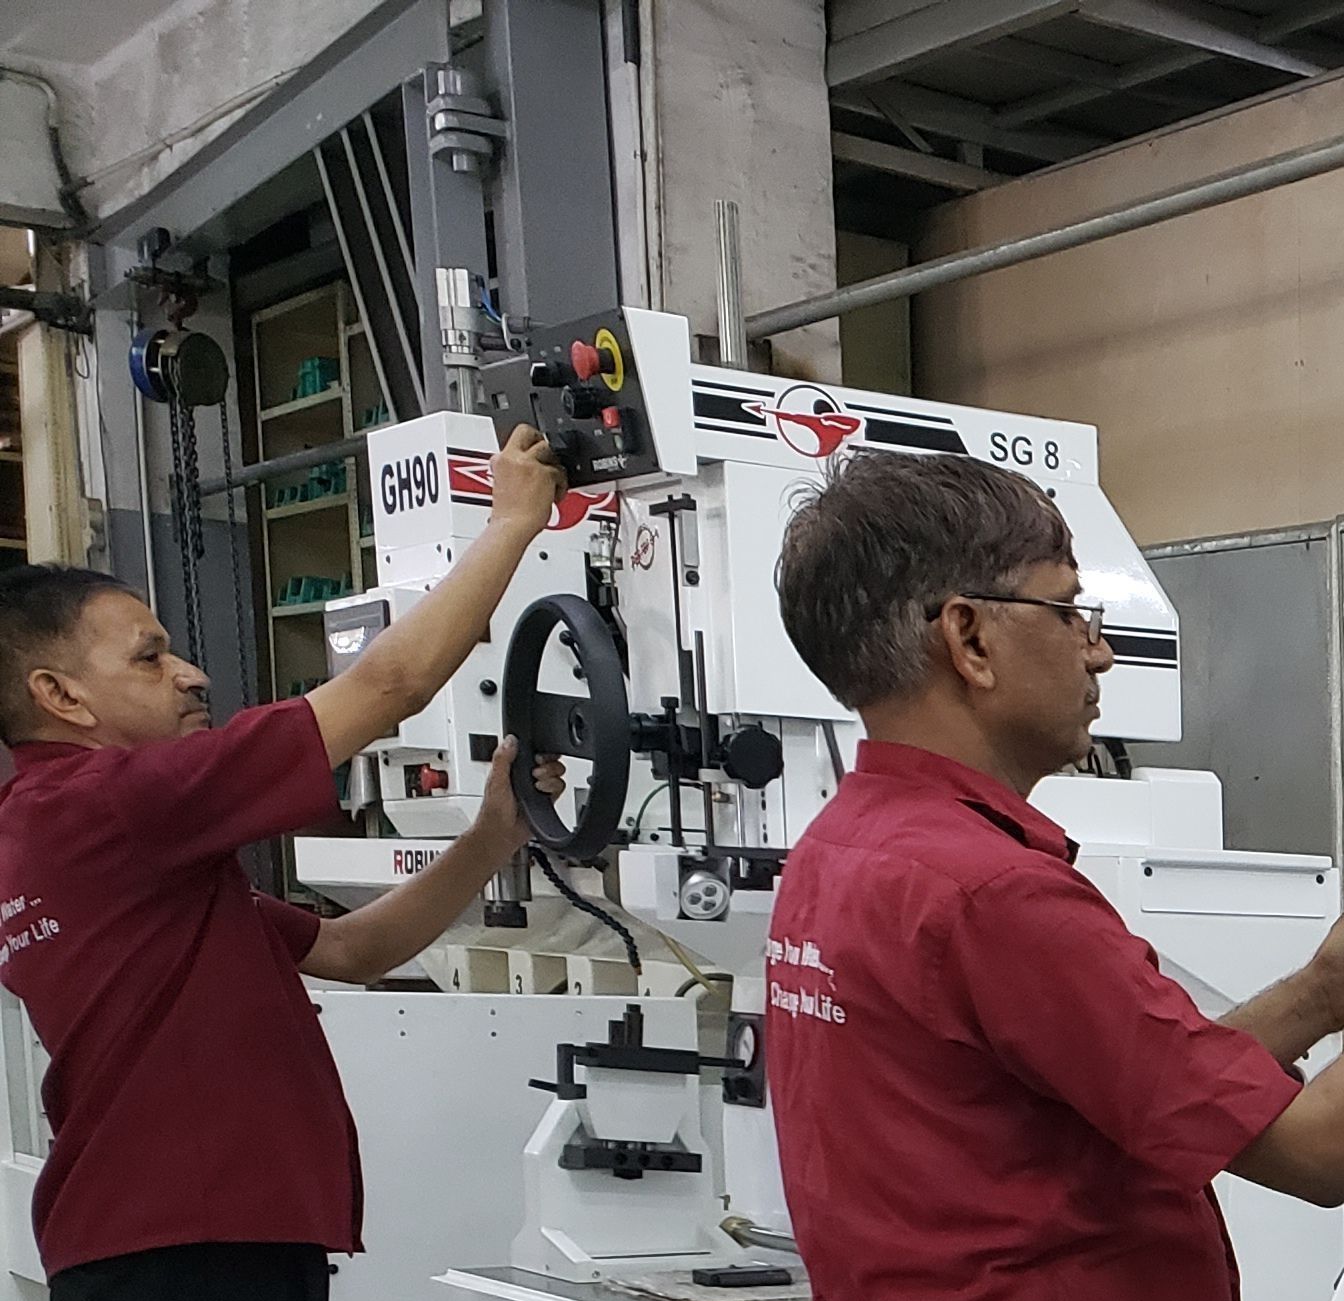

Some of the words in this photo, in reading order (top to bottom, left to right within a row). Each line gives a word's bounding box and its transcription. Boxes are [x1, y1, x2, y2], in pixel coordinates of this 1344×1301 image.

[989, 431, 1033, 466] SG
[1044, 440, 1059, 470] 8
[381, 451, 439, 515] GH90
[30, 917, 60, 941] Life
[452, 968, 460, 990] 4
[515, 974, 523, 994] 3
[814, 988, 846, 1024] Life
